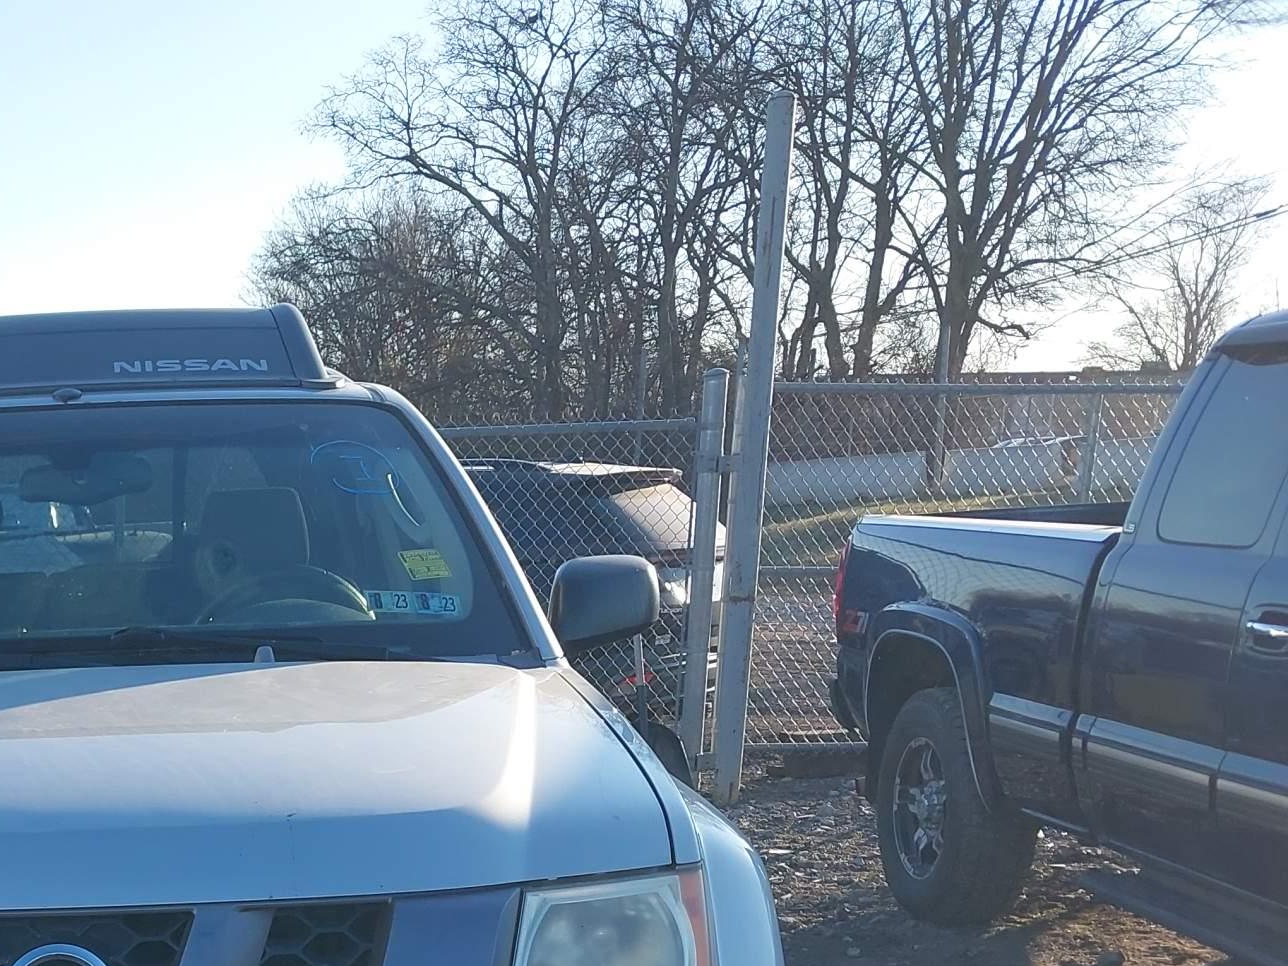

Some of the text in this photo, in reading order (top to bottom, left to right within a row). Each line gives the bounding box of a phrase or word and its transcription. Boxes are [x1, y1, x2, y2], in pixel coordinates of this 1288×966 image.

[114, 359, 268, 373] NISSAN
[393, 594, 409, 609] 23
[441, 596, 456, 612] 23
